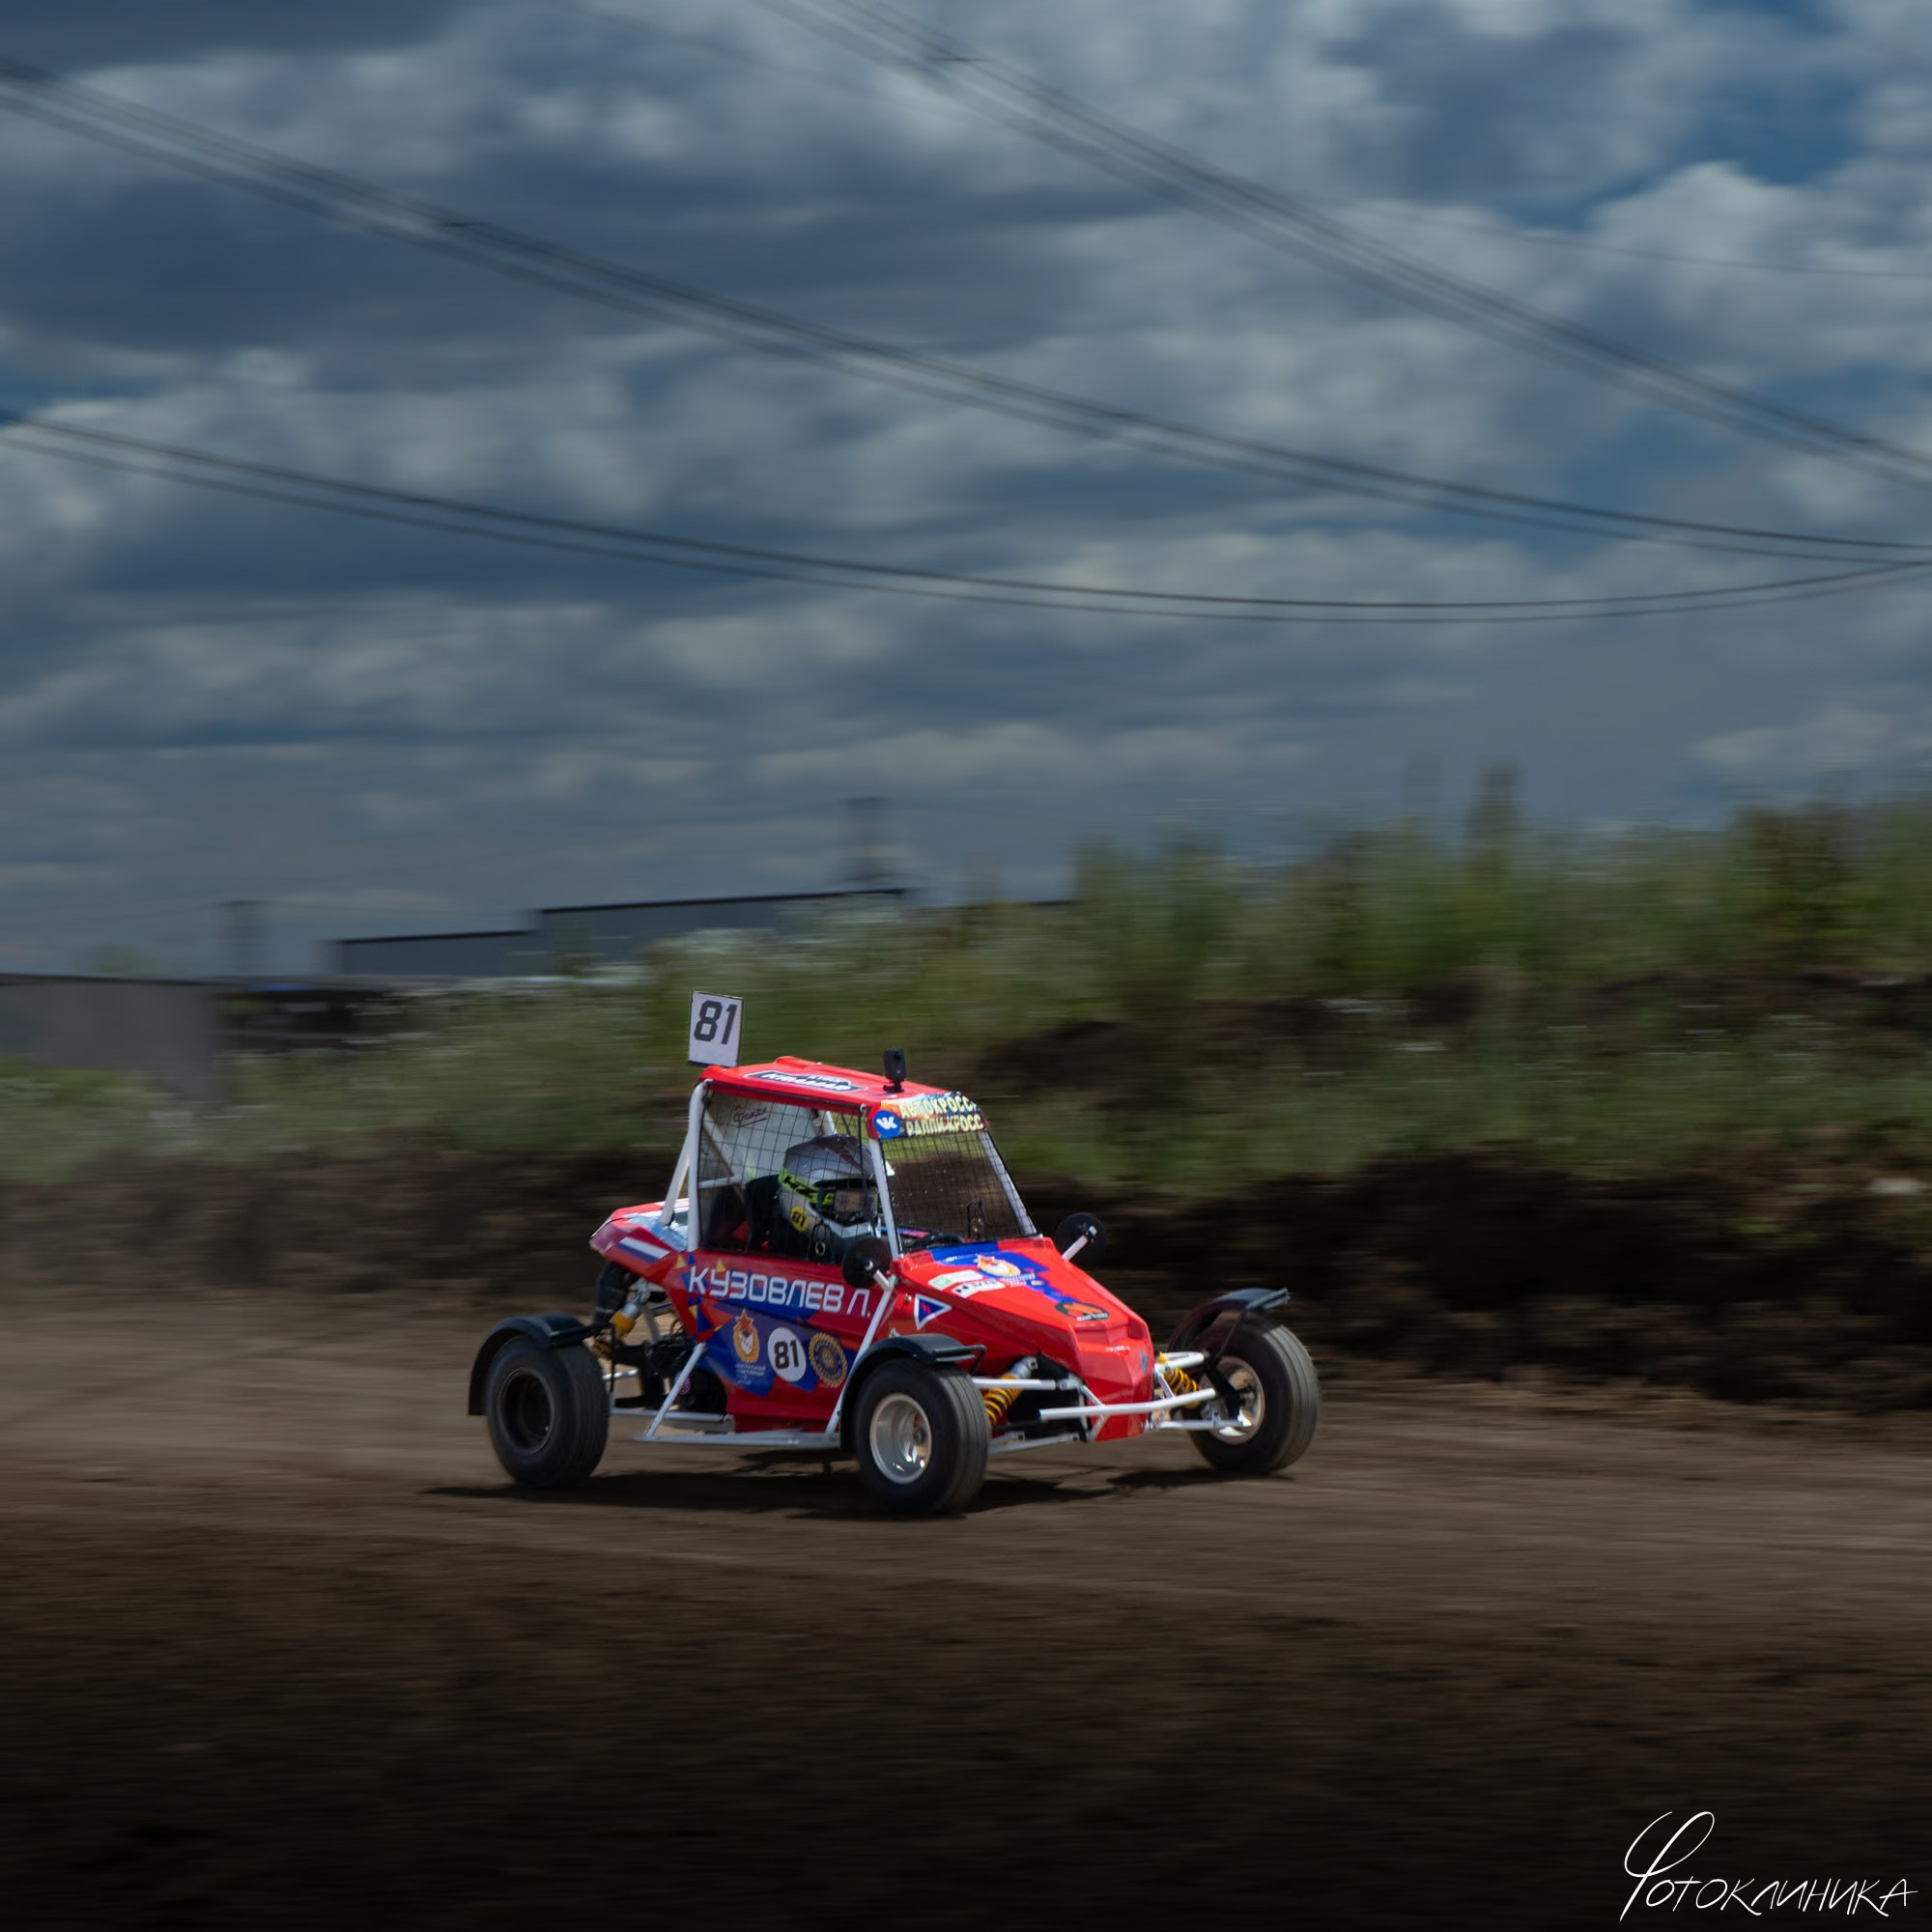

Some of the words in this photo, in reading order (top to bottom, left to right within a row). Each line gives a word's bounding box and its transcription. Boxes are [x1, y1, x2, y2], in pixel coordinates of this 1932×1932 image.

[694, 1000, 737, 1044] 81
[898, 1095, 973, 1119] АВТОКРОСС
[688, 1265, 844, 1313] КУЗОВЛЕВ
[846, 1288, 871, 1318] Л.
[774, 1340, 799, 1370] 81
